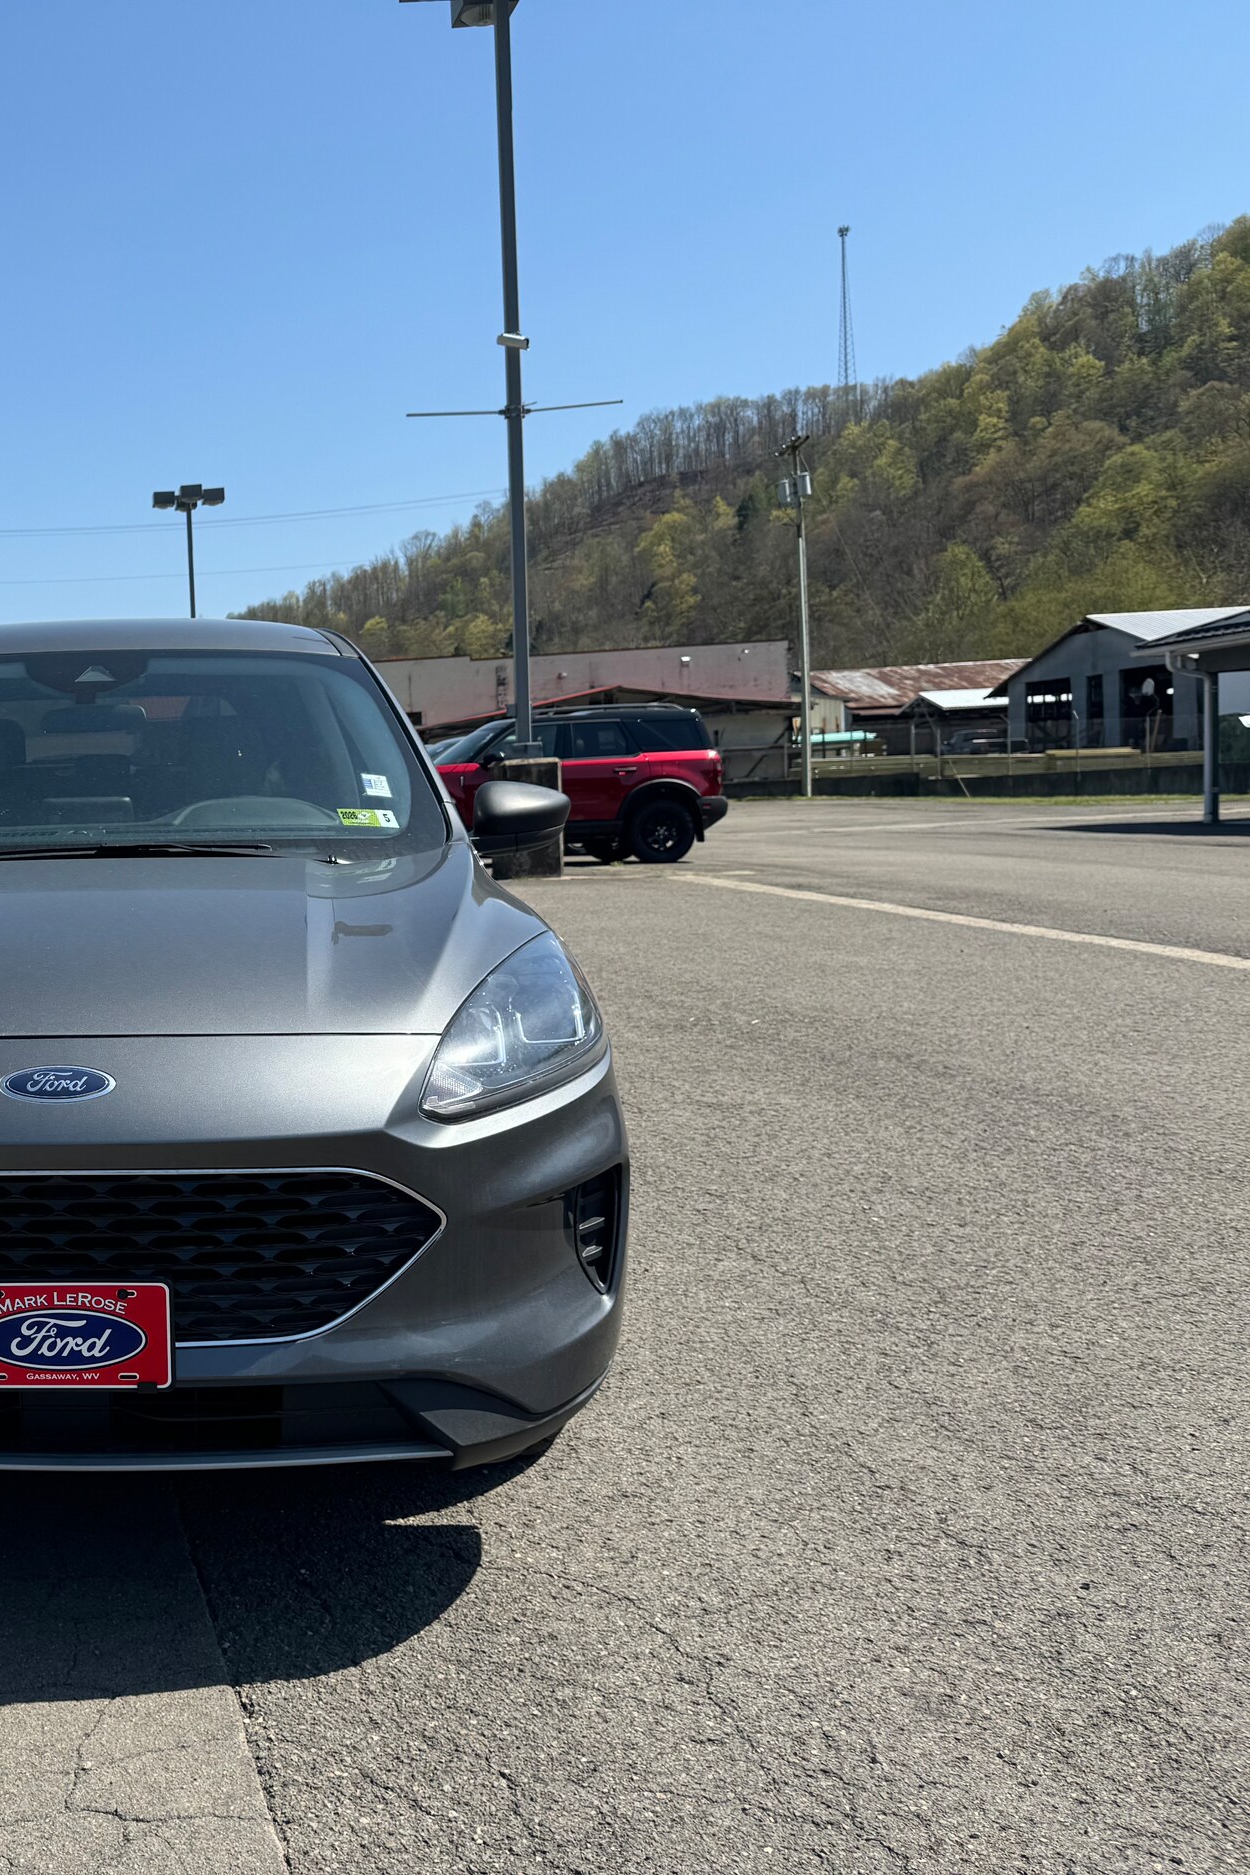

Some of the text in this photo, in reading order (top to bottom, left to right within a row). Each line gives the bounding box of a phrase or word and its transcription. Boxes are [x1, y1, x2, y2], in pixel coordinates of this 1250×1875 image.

[382, 813, 391, 823] 5
[26, 1071, 88, 1092] Ford
[10, 1317, 113, 1357] Ford
[26, 1373, 79, 1381] GASSAWAY,
